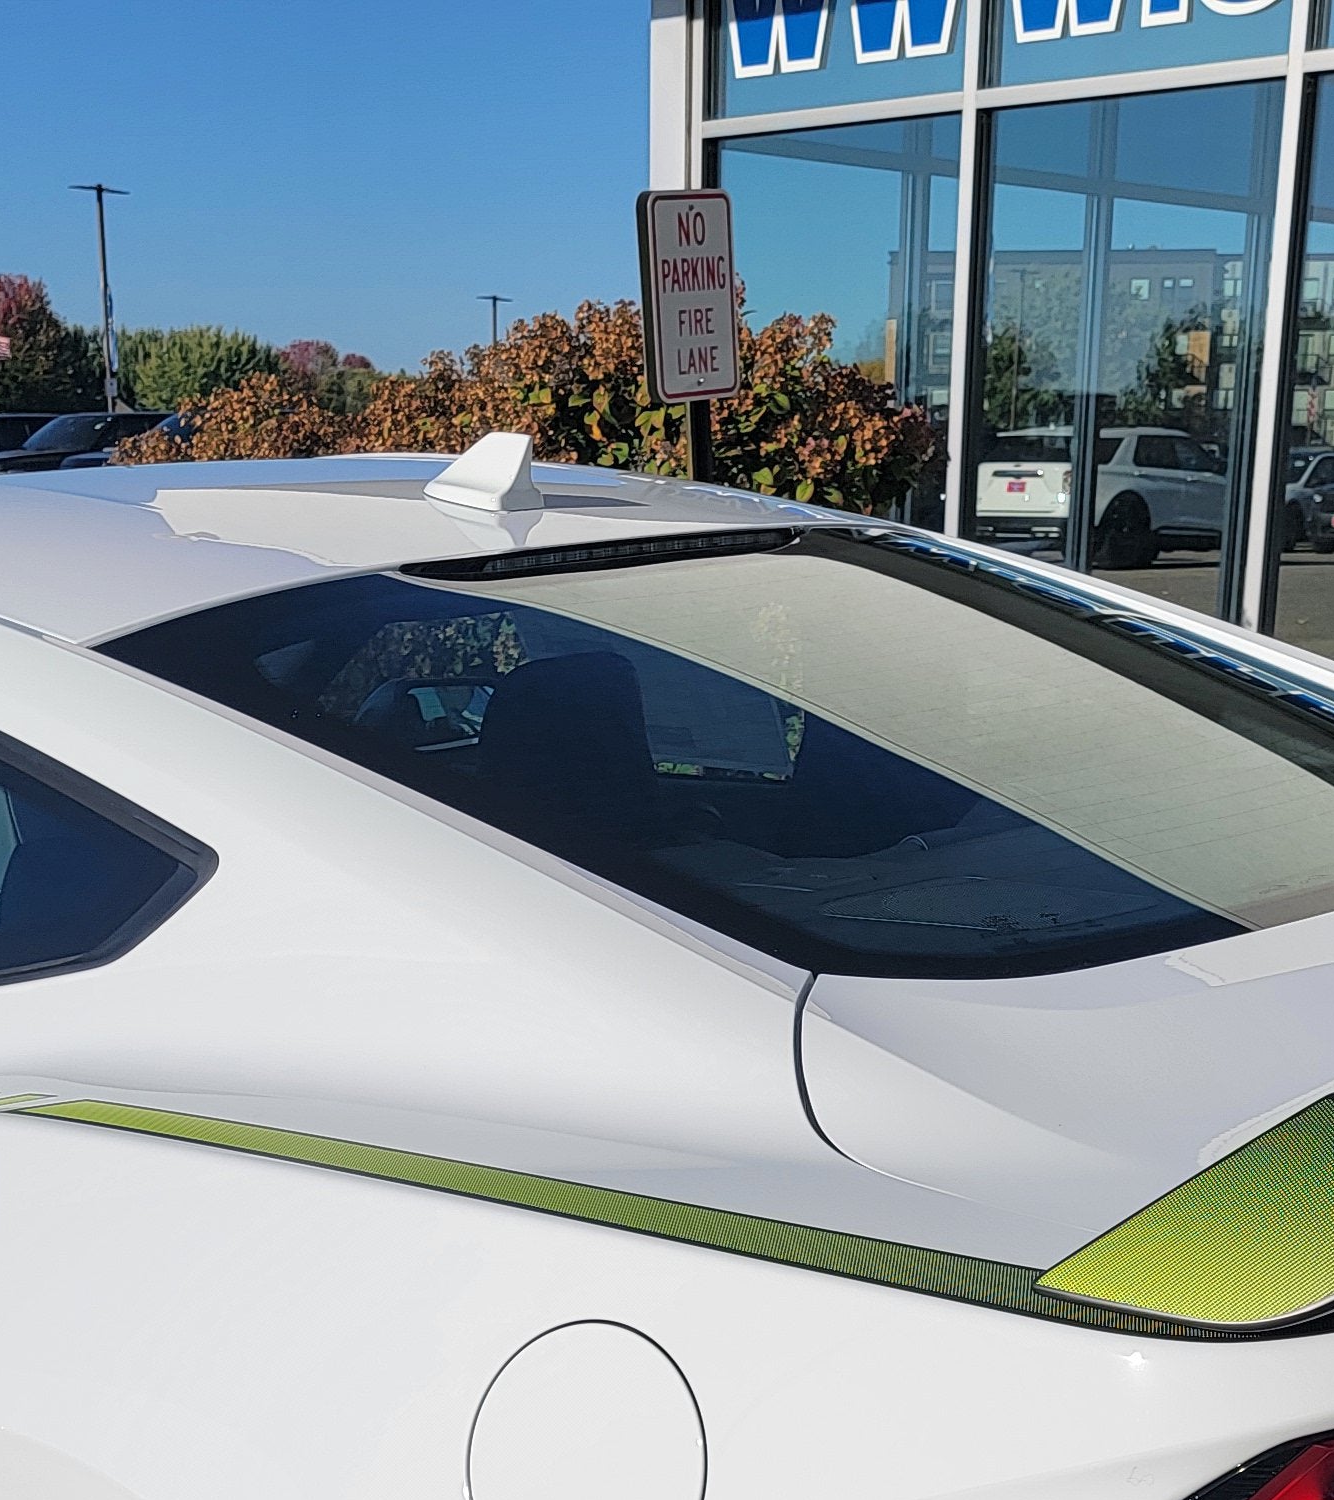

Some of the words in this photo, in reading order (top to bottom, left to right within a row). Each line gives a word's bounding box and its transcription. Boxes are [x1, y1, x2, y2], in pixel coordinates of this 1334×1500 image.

[677, 210, 706, 248] NO
[661, 254, 727, 295] PARKING
[678, 306, 715, 338] FIRE
[677, 345, 720, 376] LANE
